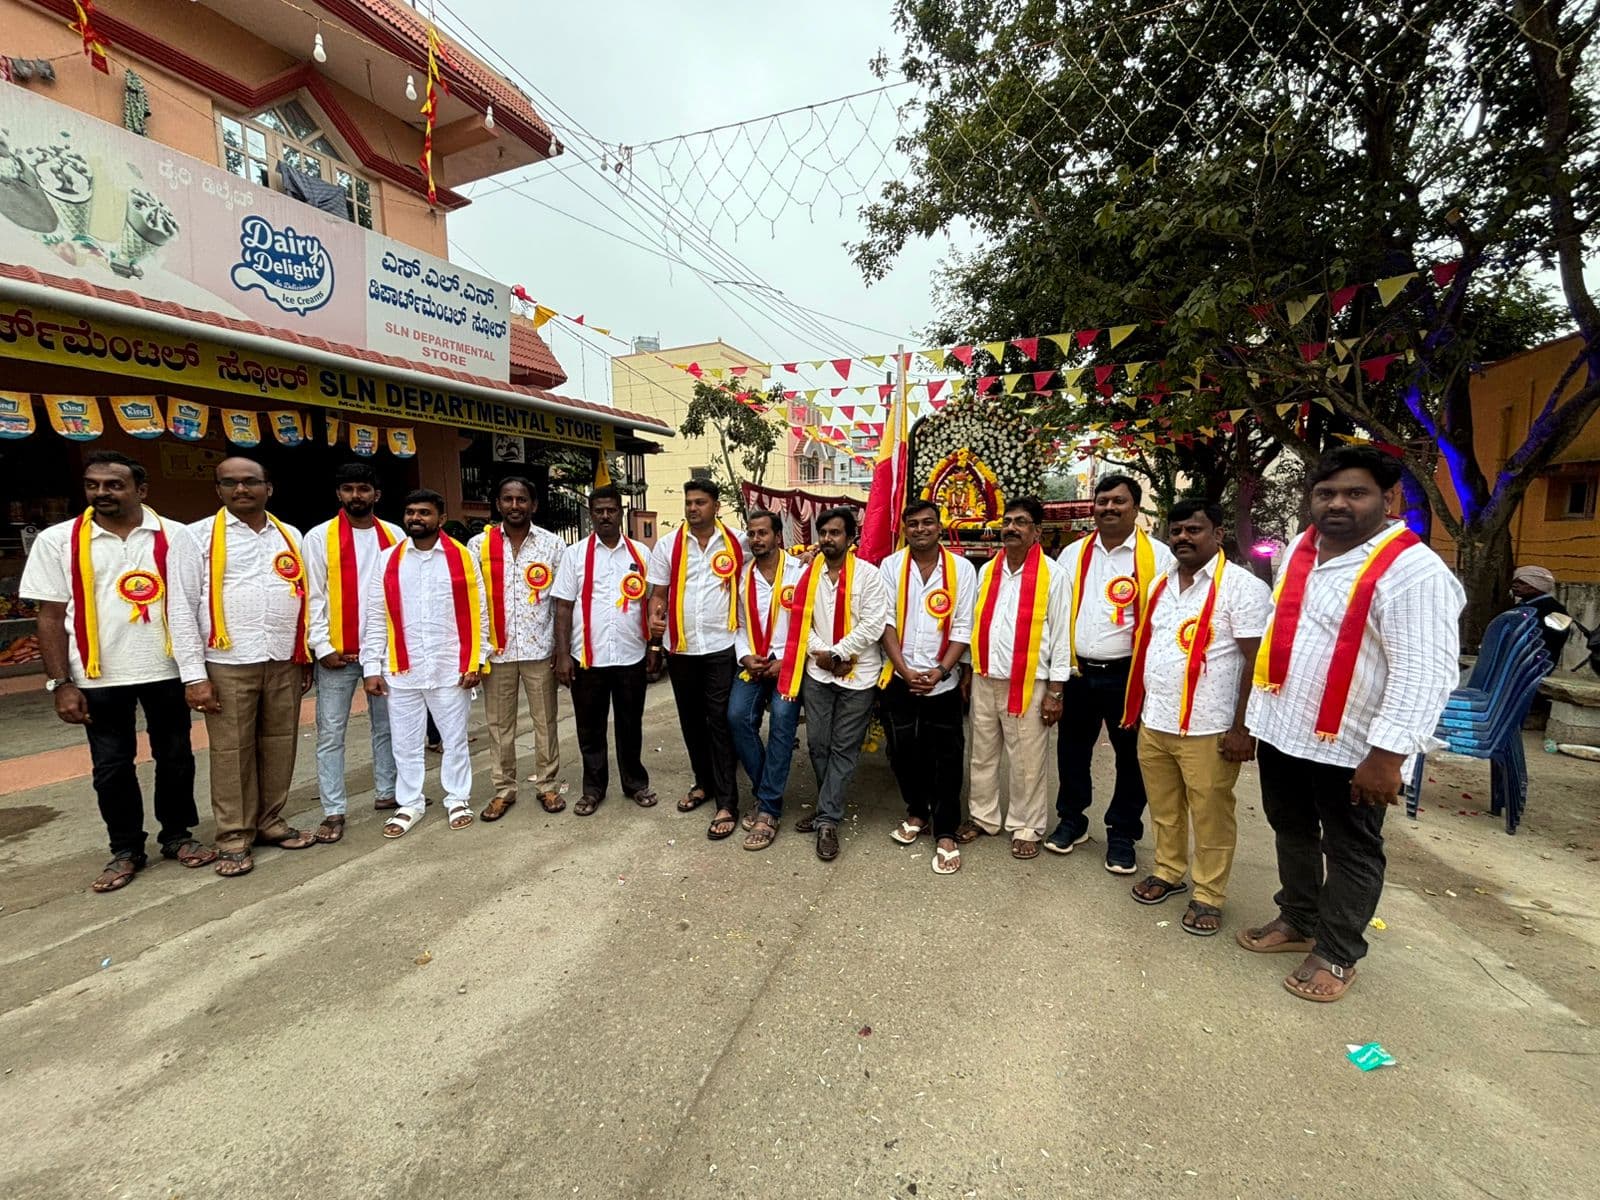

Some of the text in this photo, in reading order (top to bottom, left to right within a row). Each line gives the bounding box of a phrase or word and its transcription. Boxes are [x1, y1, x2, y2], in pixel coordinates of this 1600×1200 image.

[243, 219, 320, 265] Dairy
[252, 251, 320, 281] Delight
[282, 290, 325, 305] Ice Creams
[385, 321, 496, 361] SLN DEPARTMENTAL
[422, 346, 467, 366] STORE
[319, 370, 602, 442] SLN DEPARTMENTAL STORE
